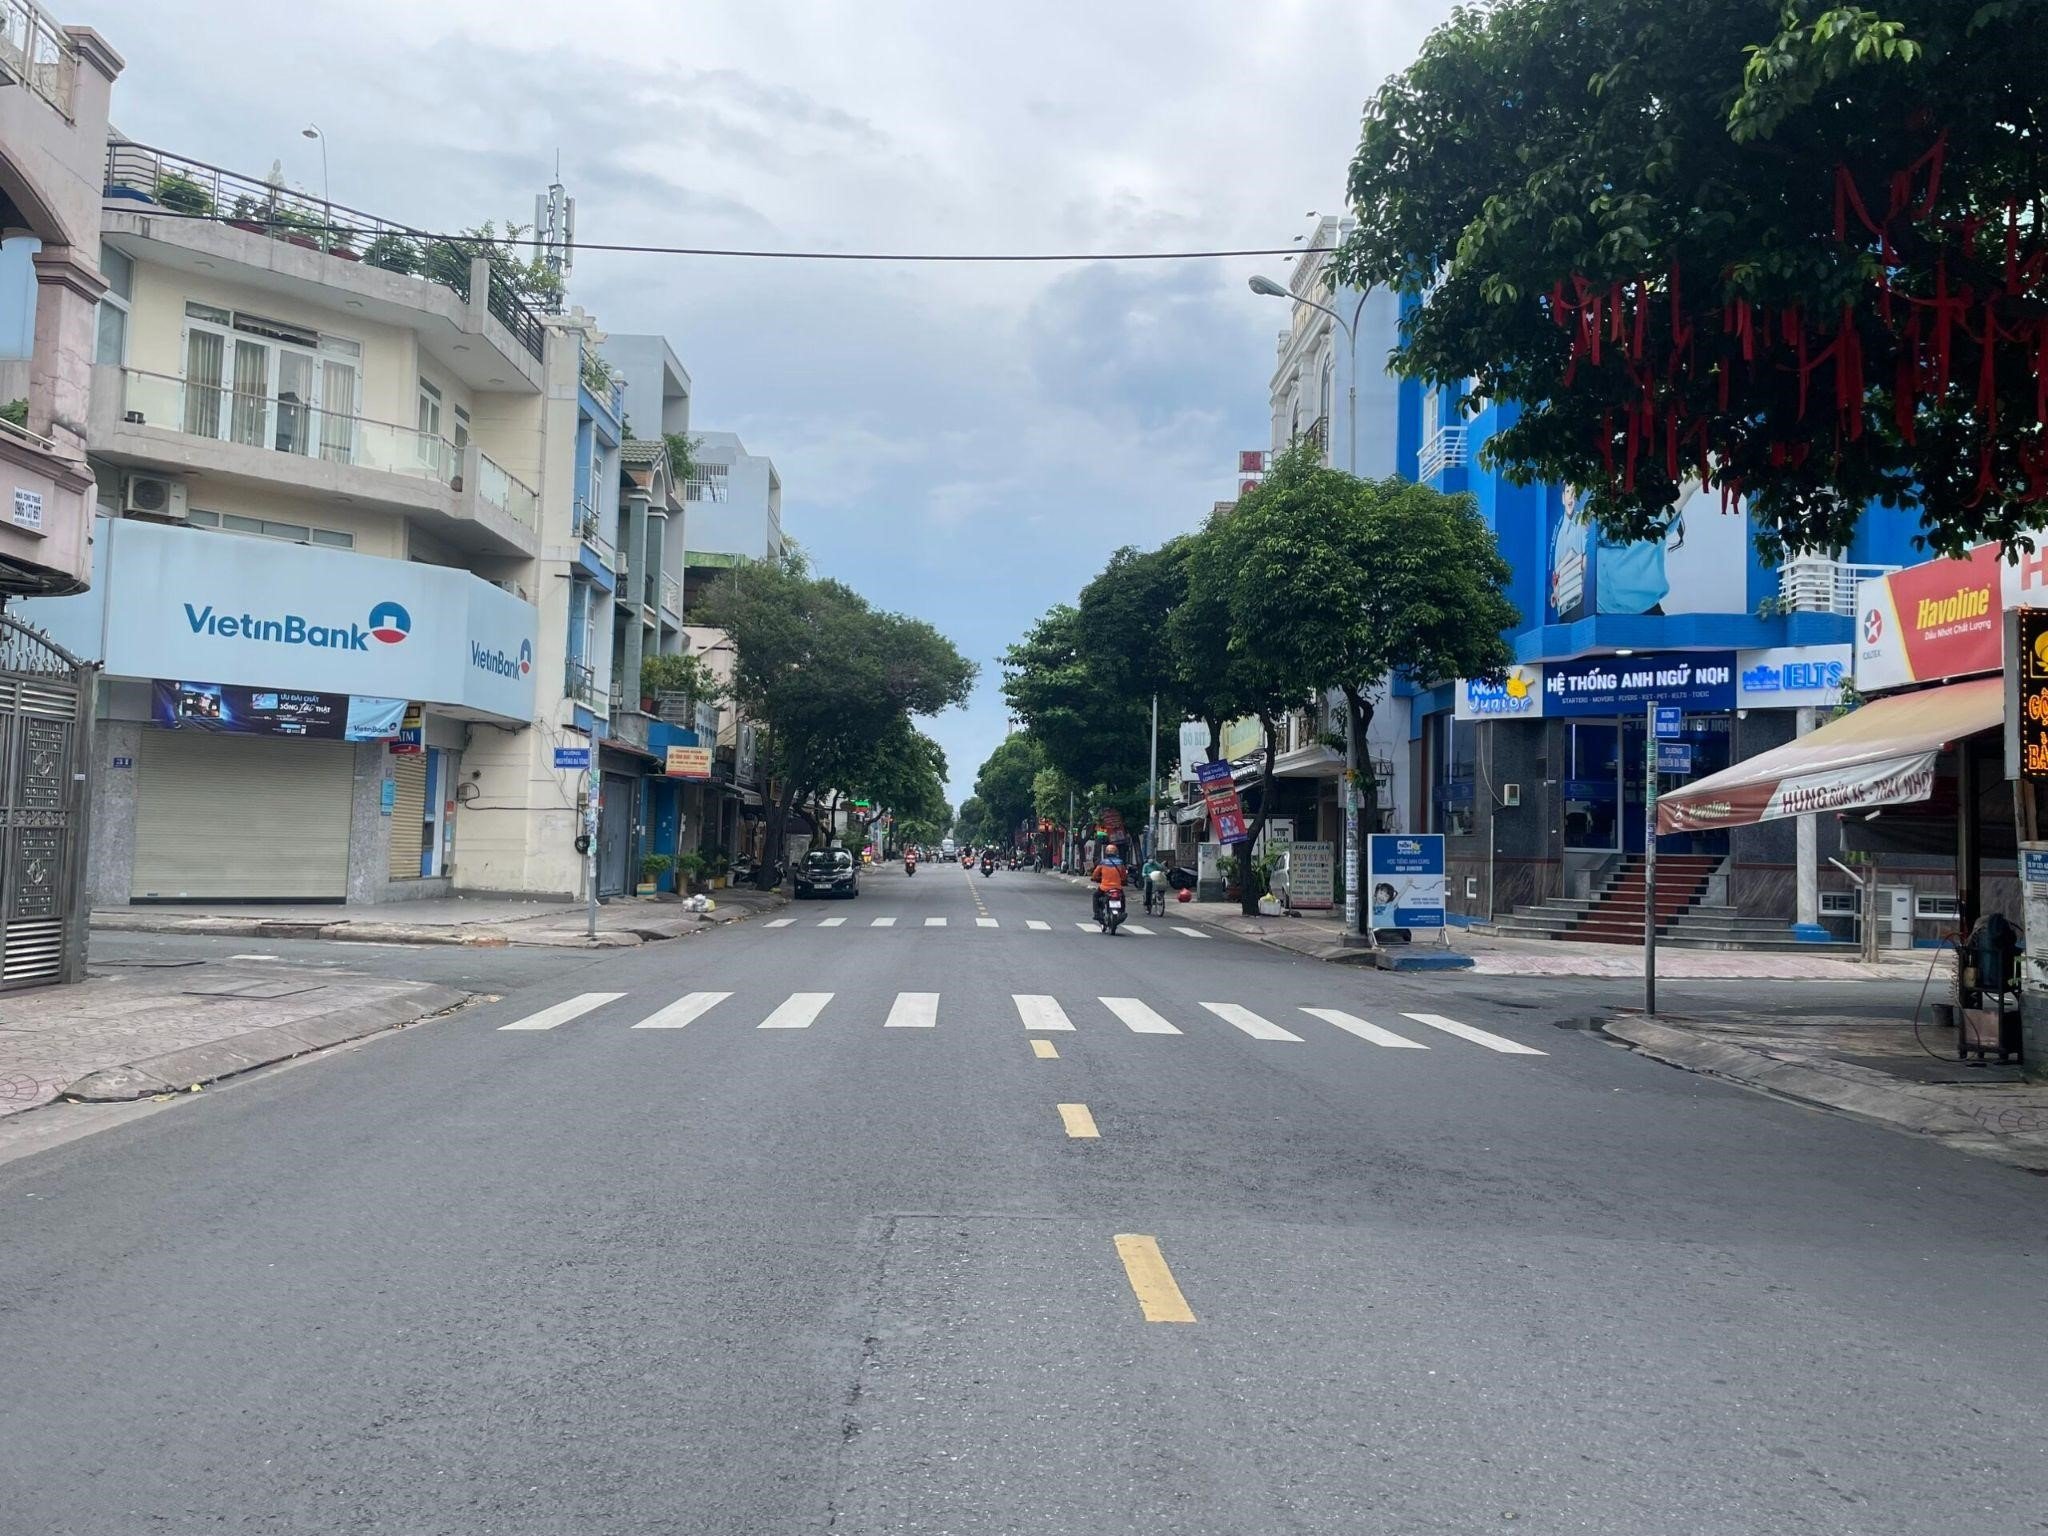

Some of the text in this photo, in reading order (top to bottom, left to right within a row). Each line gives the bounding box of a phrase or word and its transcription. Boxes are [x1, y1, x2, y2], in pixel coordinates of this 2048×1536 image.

[1916, 587, 1990, 630] Havoline
[184, 602, 369, 651] VietinBank
[1954, 624, 1968, 634] Chất
[1969, 620, 1991, 631] Lượng
[472, 640, 520, 680] VietinBank
[1782, 660, 1844, 689] IELTS
[1547, 664, 1729, 696] HỆ THỐNG ANH NGỮ NQH
[280, 703, 298, 711] SỐNG
[316, 706, 331, 714] THẬT
[1470, 695, 1532, 713] Junior
[354, 725, 388, 734] VietinBank
[1689, 800, 1731, 818] Havoline
[1782, 786, 1827, 814] HÙNG
[1830, 781, 1852, 806] RỬA
[1874, 779, 1900, 800] THAY
